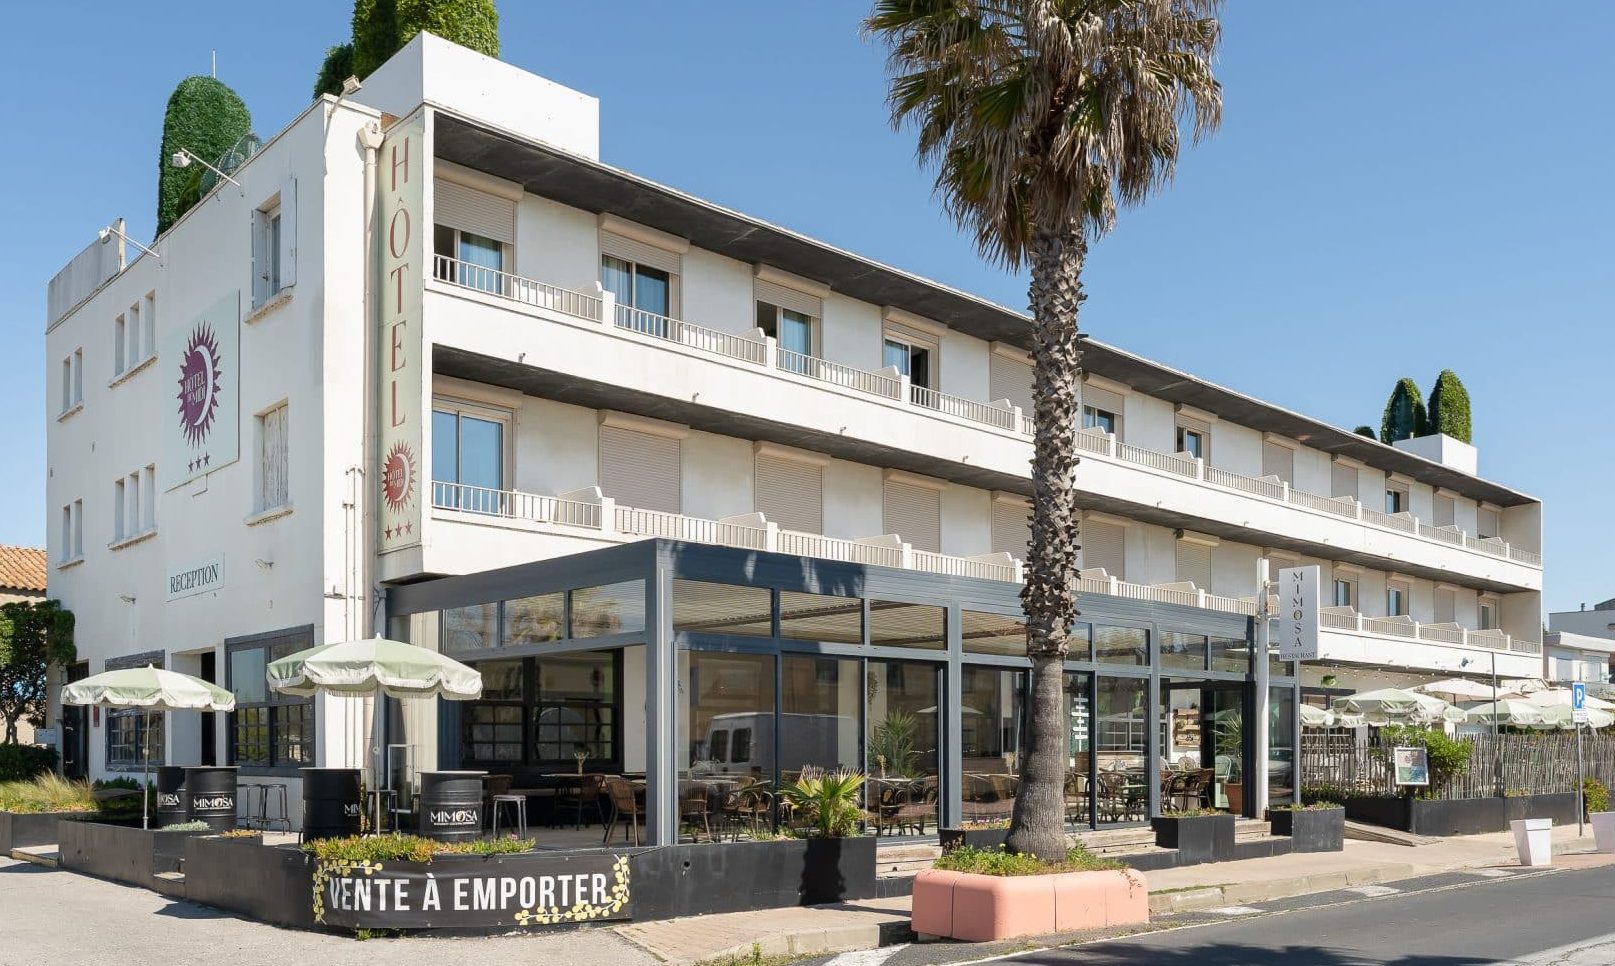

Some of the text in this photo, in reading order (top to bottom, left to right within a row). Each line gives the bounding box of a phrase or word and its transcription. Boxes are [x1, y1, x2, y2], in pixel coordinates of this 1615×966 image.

[390, 136, 411, 429] HÔTEL
[170, 563, 219, 593] RECEPTION
[1293, 570, 1303, 648] MIMOSA
[1576, 687, 1583, 707] P
[193, 797, 234, 808] MIMOSA
[430, 809, 478, 823] MIMOSA
[329, 872, 607, 912] VENTE À EMPORTER
